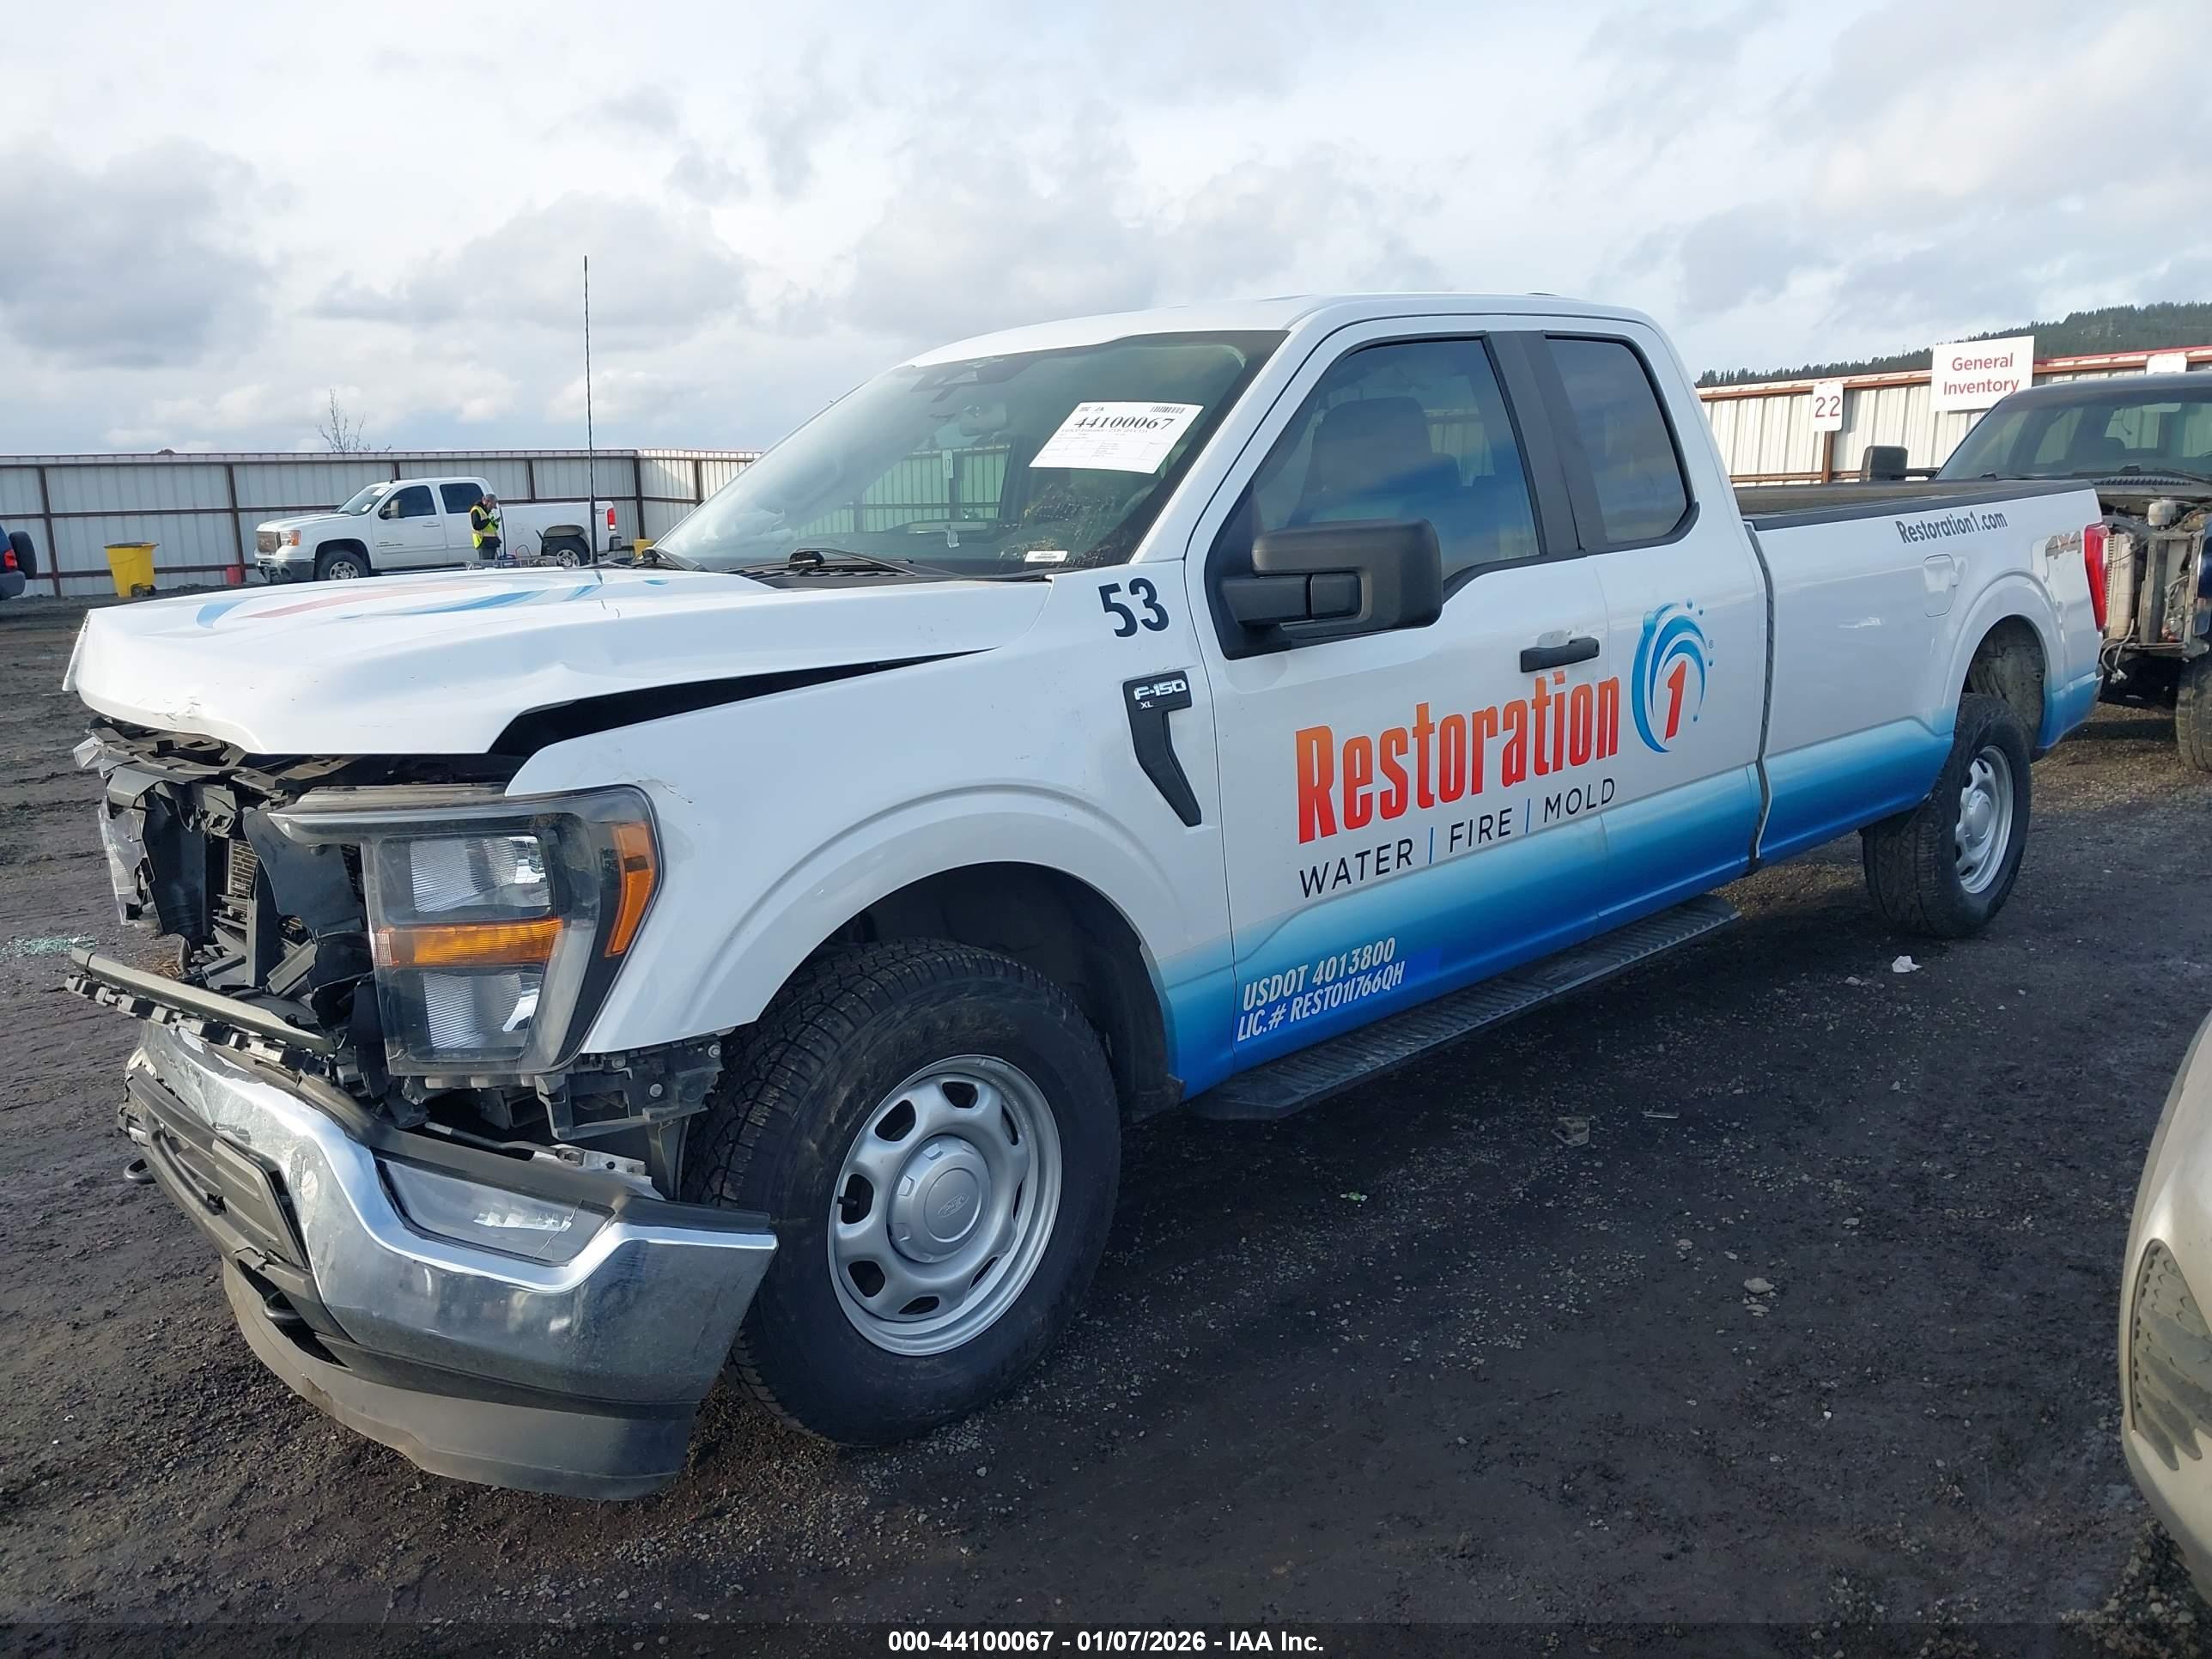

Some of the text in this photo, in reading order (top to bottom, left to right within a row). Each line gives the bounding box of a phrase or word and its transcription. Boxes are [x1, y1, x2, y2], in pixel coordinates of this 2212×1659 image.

[1951, 352, 2014, 371] General
[1943, 378, 2020, 395] Inventory
[1814, 395, 1841, 418] 22
[1073, 416, 1176, 430] 44100067
[1895, 510, 2008, 544] Restoration1.com
[1098, 577, 1170, 638] 53
[1133, 679, 1188, 701] F-150
[1139, 701, 1154, 709] XL
[1295, 659, 1687, 846] Restoration 1
[1298, 776, 1616, 899] WATER FIRE MOLD
[1243, 936, 1396, 1012] USDOT 4013800
[1237, 1002, 1287, 1042] LIC.#
